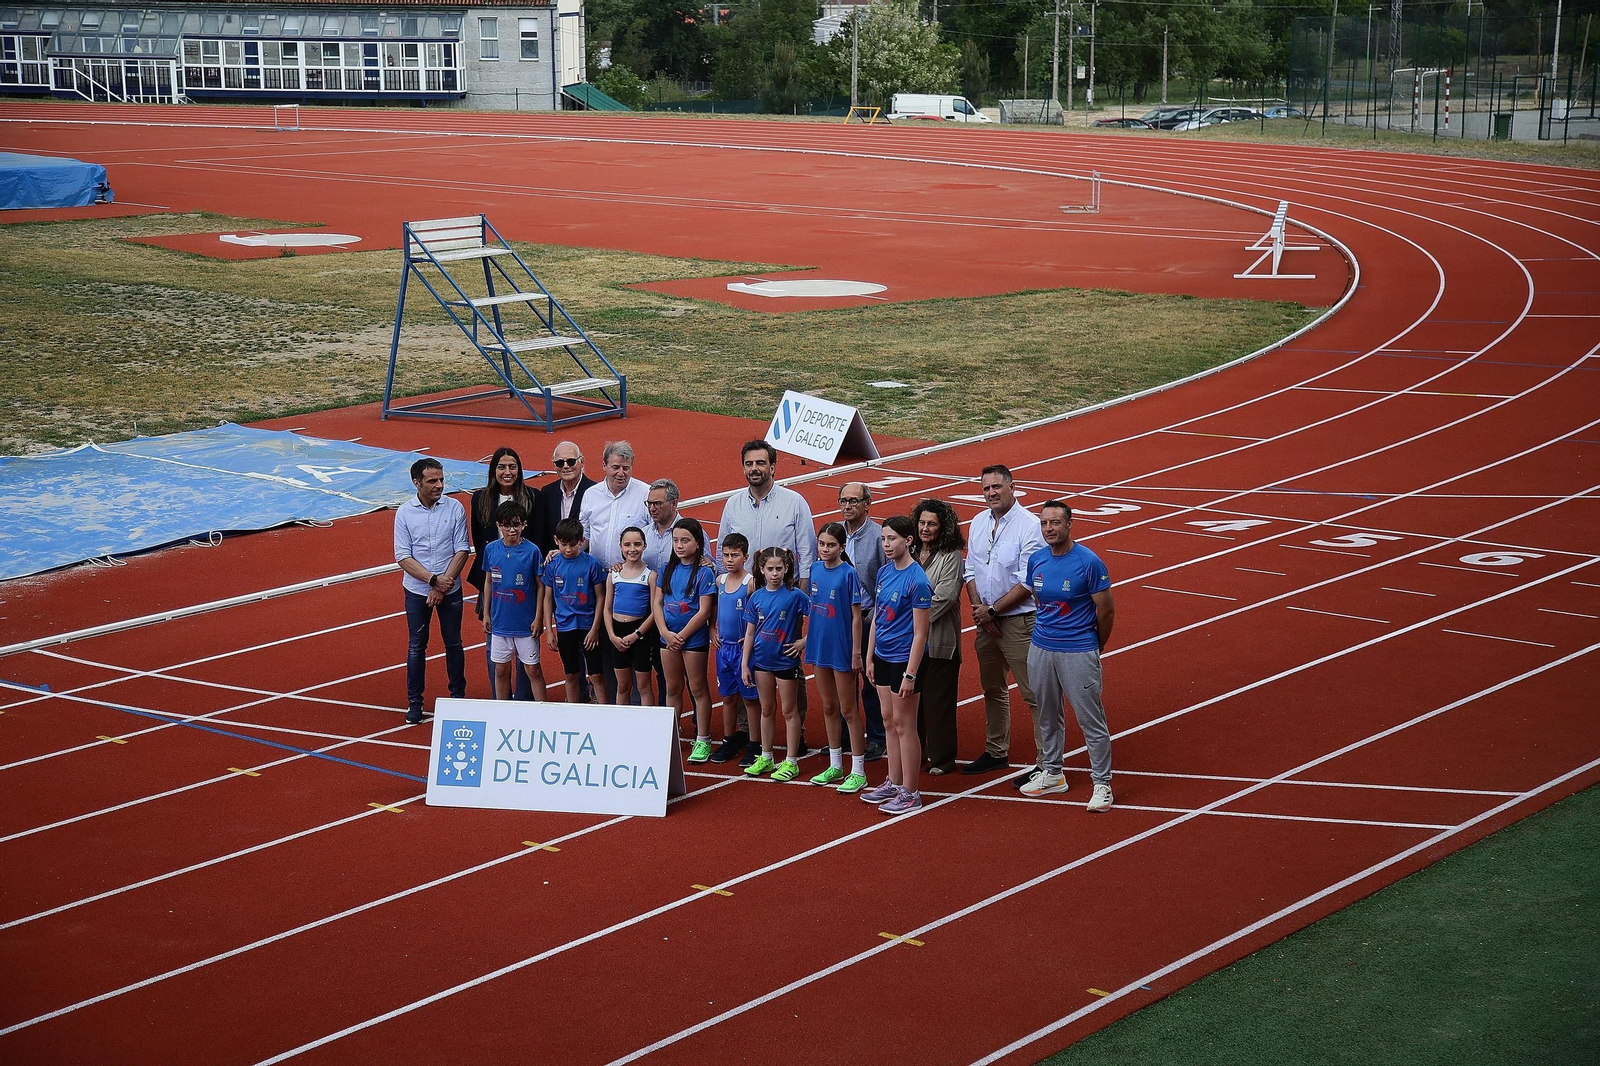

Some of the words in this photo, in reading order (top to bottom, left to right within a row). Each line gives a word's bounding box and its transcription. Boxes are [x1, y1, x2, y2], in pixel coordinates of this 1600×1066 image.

[803, 409, 847, 432] DEPORTE
[795, 429, 834, 451] GALEGO
[1071, 503, 1142, 515] 3
[1184, 519, 1272, 532] 4
[1308, 533, 1404, 547] 5
[1458, 551, 1546, 566] 6
[496, 728, 597, 756] XUNTA
[493, 759, 531, 783] DE
[540, 761, 660, 790] GALICIA
